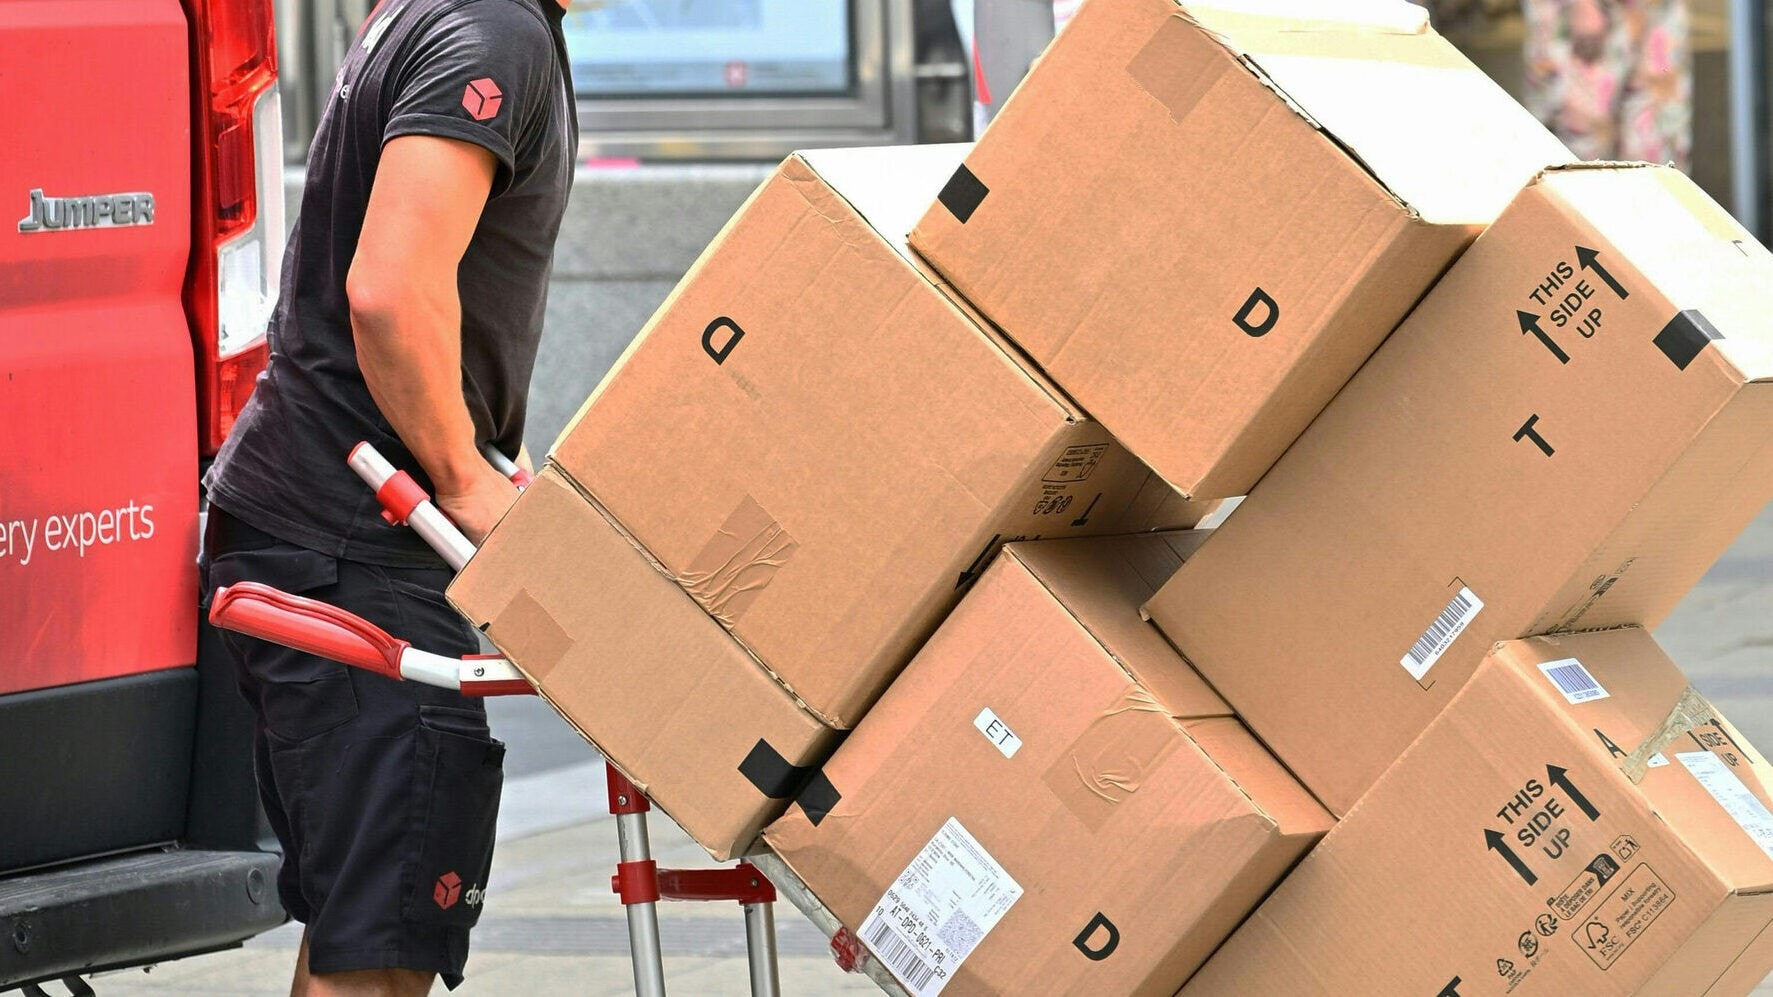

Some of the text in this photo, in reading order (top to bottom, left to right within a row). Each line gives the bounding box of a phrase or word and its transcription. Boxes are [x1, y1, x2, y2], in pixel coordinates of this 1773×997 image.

[1529, 261, 1574, 306] THIS
[1550, 279, 1595, 328] SIDE
[1232, 287, 1280, 338] D
[1576, 308, 1603, 339] UP
[701, 316, 745, 365] D
[1512, 413, 1555, 458] T
[45, 499, 155, 558] experts
[986, 719, 1014, 745] ET
[1496, 779, 1544, 824] THIS
[1517, 798, 1565, 847] SIDE
[1543, 828, 1570, 859] UP
[1072, 911, 1120, 961] D
[1599, 935, 1620, 957] FSC
